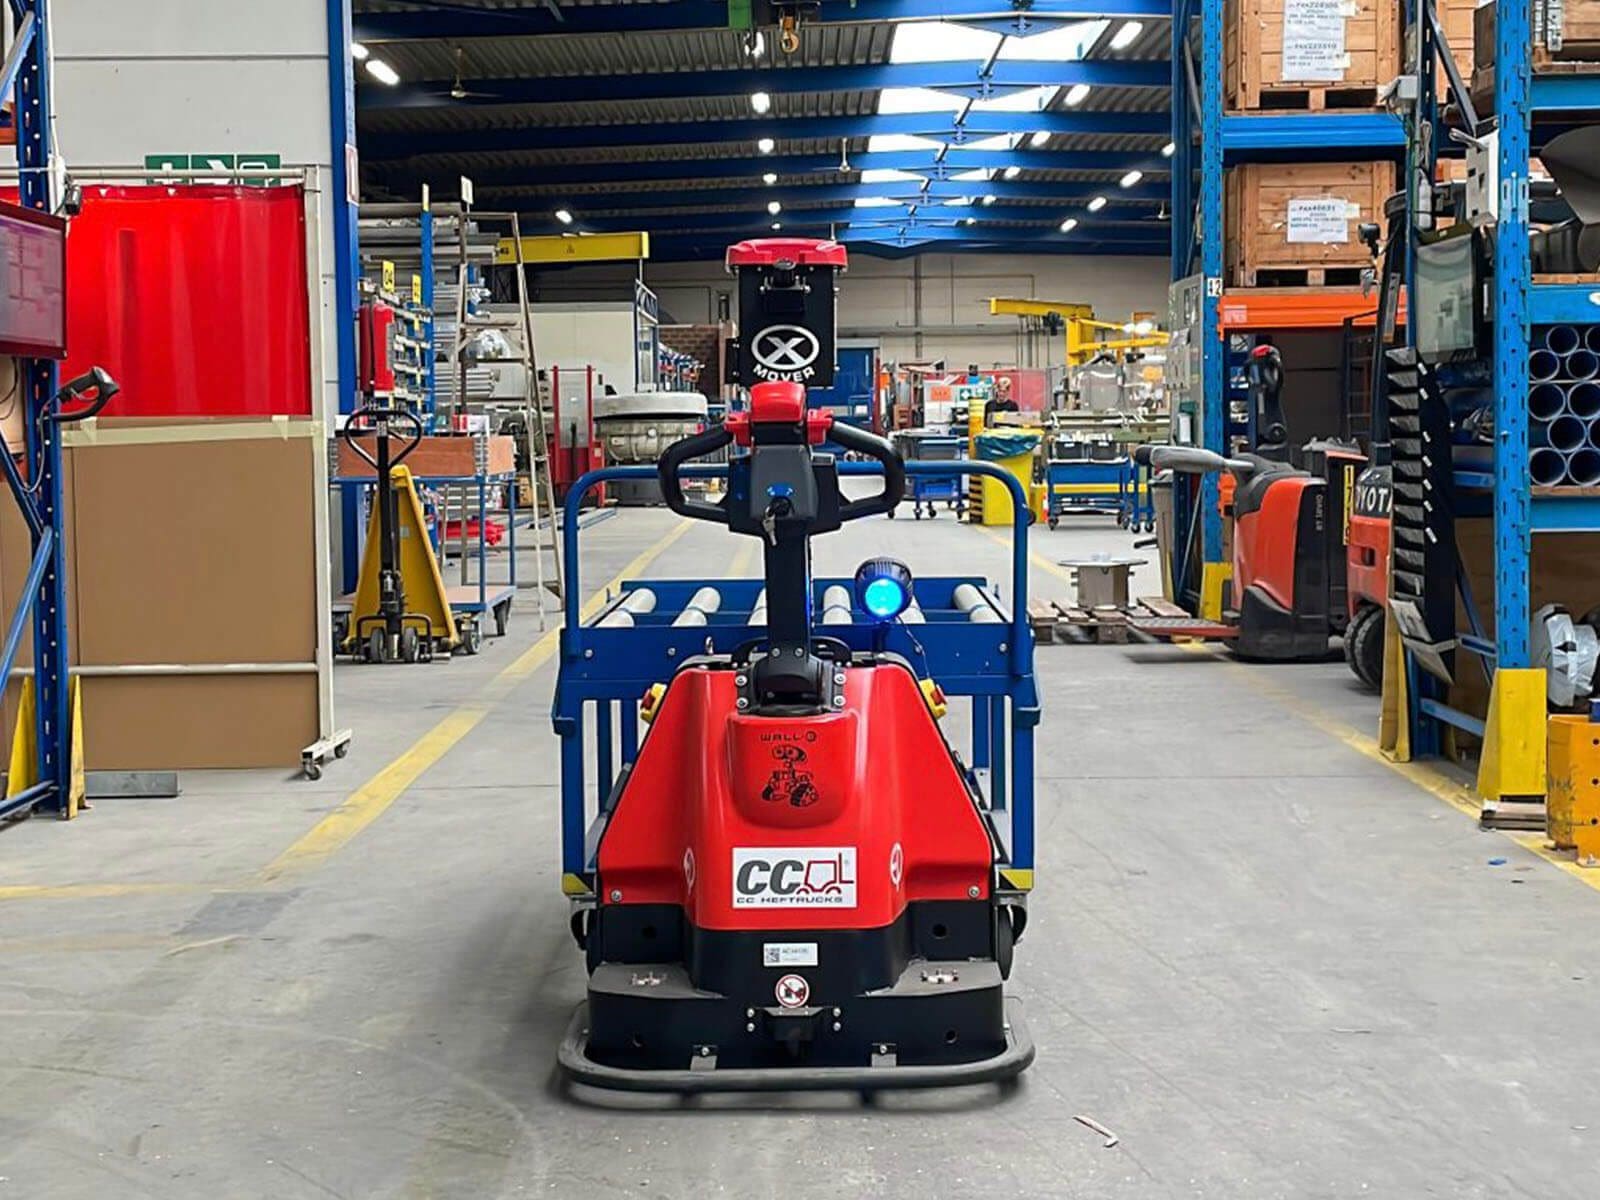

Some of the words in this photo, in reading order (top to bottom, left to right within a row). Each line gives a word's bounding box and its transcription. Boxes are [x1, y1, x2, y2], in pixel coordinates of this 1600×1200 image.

[752, 363, 816, 382] MOVER
[736, 859, 804, 895] CC
[761, 896, 843, 904] HEFTRUCKS
